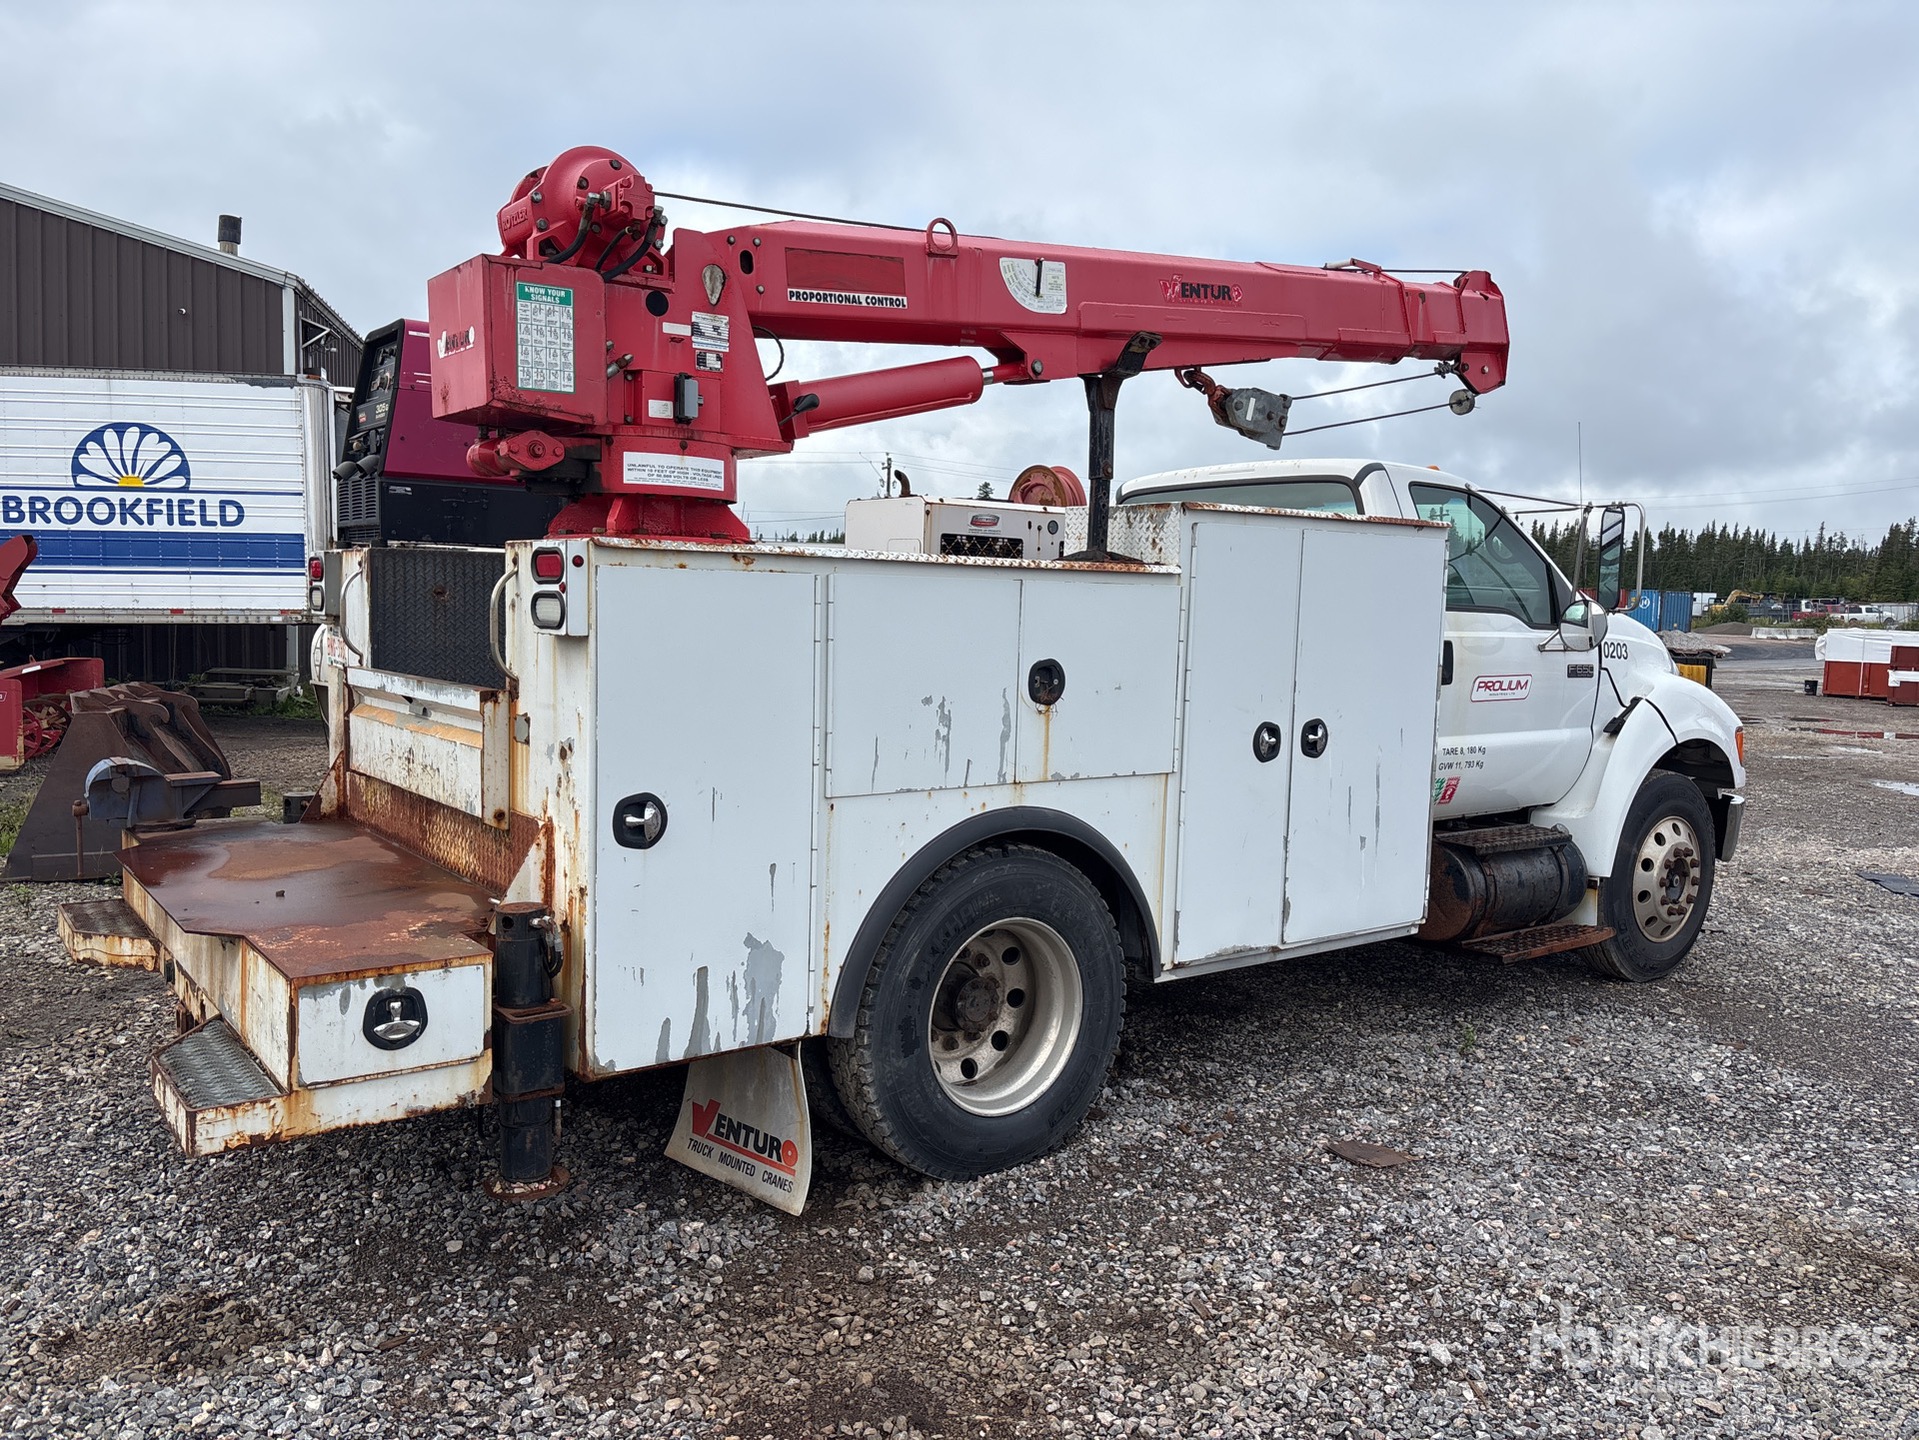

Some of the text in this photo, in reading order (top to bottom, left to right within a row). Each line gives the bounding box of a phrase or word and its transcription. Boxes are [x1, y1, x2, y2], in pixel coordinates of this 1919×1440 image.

[525, 285, 566, 298] KNOW YOUR
[530, 293, 560, 304] SIGNALS
[788, 290, 906, 308] PROPORTIONAL CONTROL
[2, 495, 245, 527] BROOKFIELD
[1603, 641, 1629, 660] 0203
[1476, 679, 1529, 692] PROLIUM
[1442, 747, 1459, 756] TARE
[1477, 746, 1486, 756] Kg
[1438, 762, 1454, 771] GVW
[1476, 760, 1484, 770] Kg
[691, 1098, 799, 1168] VENTURO
[687, 1137, 794, 1194] TRUCK MOUNTED CRANES
